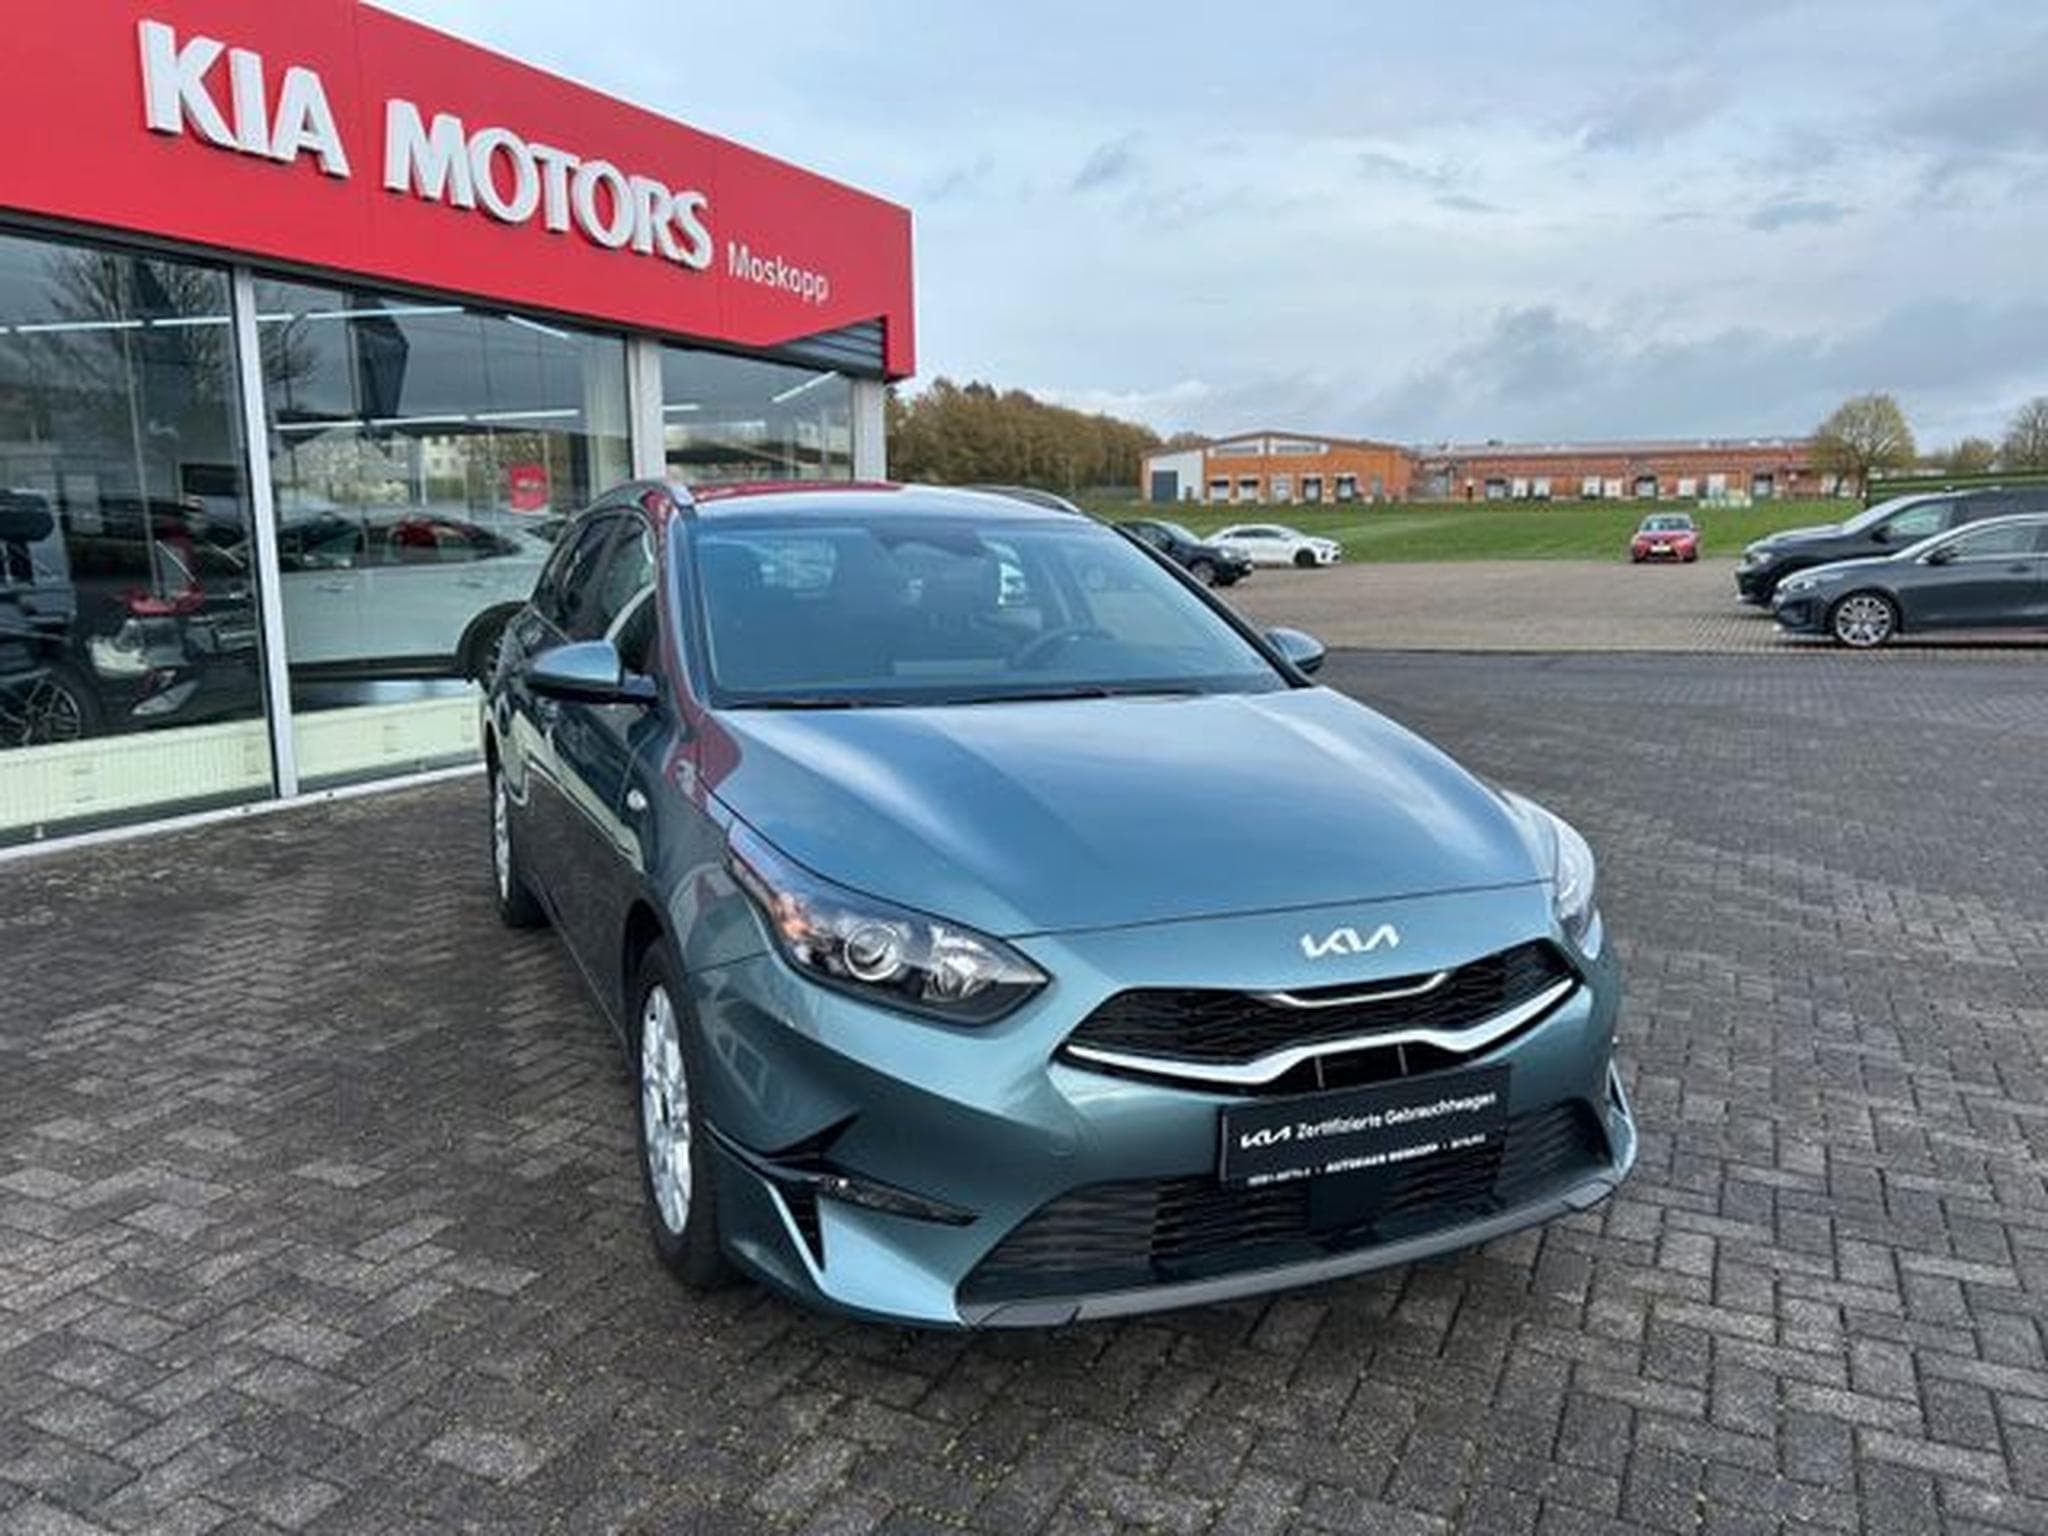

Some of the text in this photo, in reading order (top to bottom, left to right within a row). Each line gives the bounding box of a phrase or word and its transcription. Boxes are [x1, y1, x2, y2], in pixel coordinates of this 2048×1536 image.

[137, 18, 712, 270] KIA MOTORS
[727, 240, 830, 306] Moskopp
